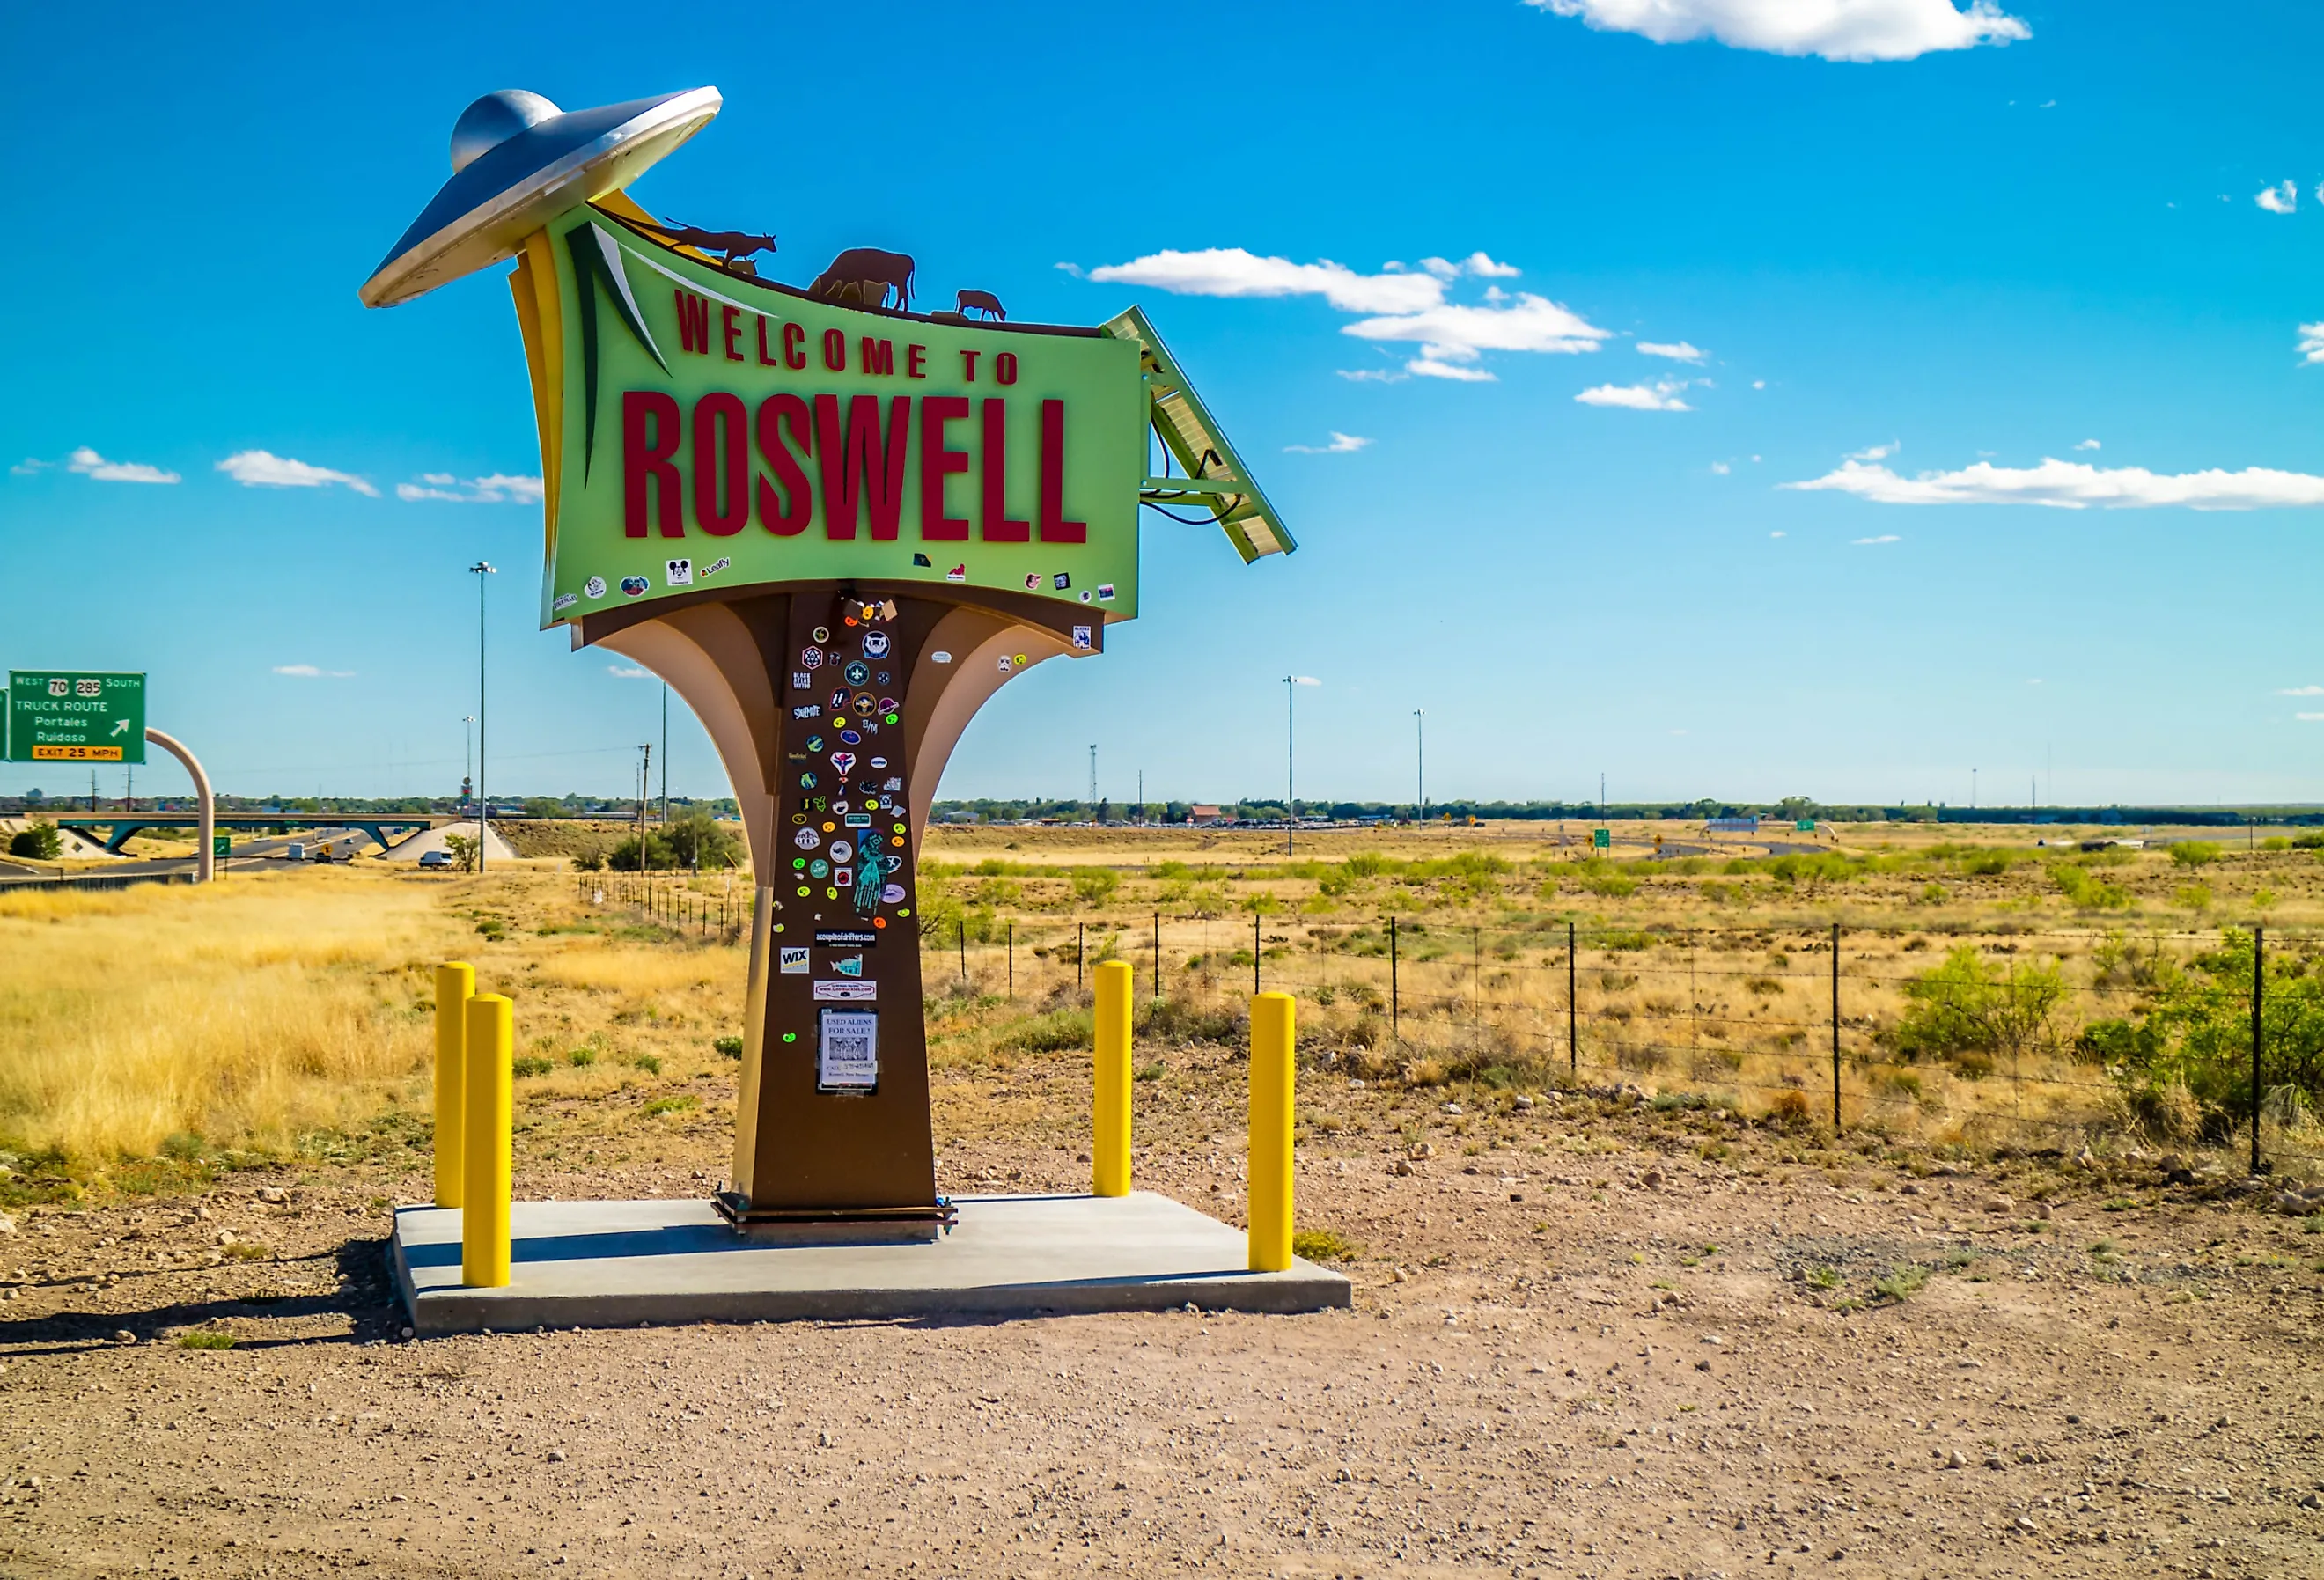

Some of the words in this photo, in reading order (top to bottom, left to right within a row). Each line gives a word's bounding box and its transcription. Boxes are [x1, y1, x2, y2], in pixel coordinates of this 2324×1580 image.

[673, 288, 927, 379] WELCOME
[960, 349, 1019, 386] TO
[622, 391, 1088, 544] ROSWELL
[707, 558, 730, 574] Leafly
[50, 681, 67, 693] 70
[77, 682, 100, 694] 285
[106, 678, 140, 687] SOUTH
[16, 701, 59, 711] TRUCK
[64, 702, 107, 712] ROUTE
[35, 716, 88, 727] Portales
[37, 731, 86, 742] Ruidoso
[69, 748, 86, 757] 25
[783, 950, 806, 965] WIX
